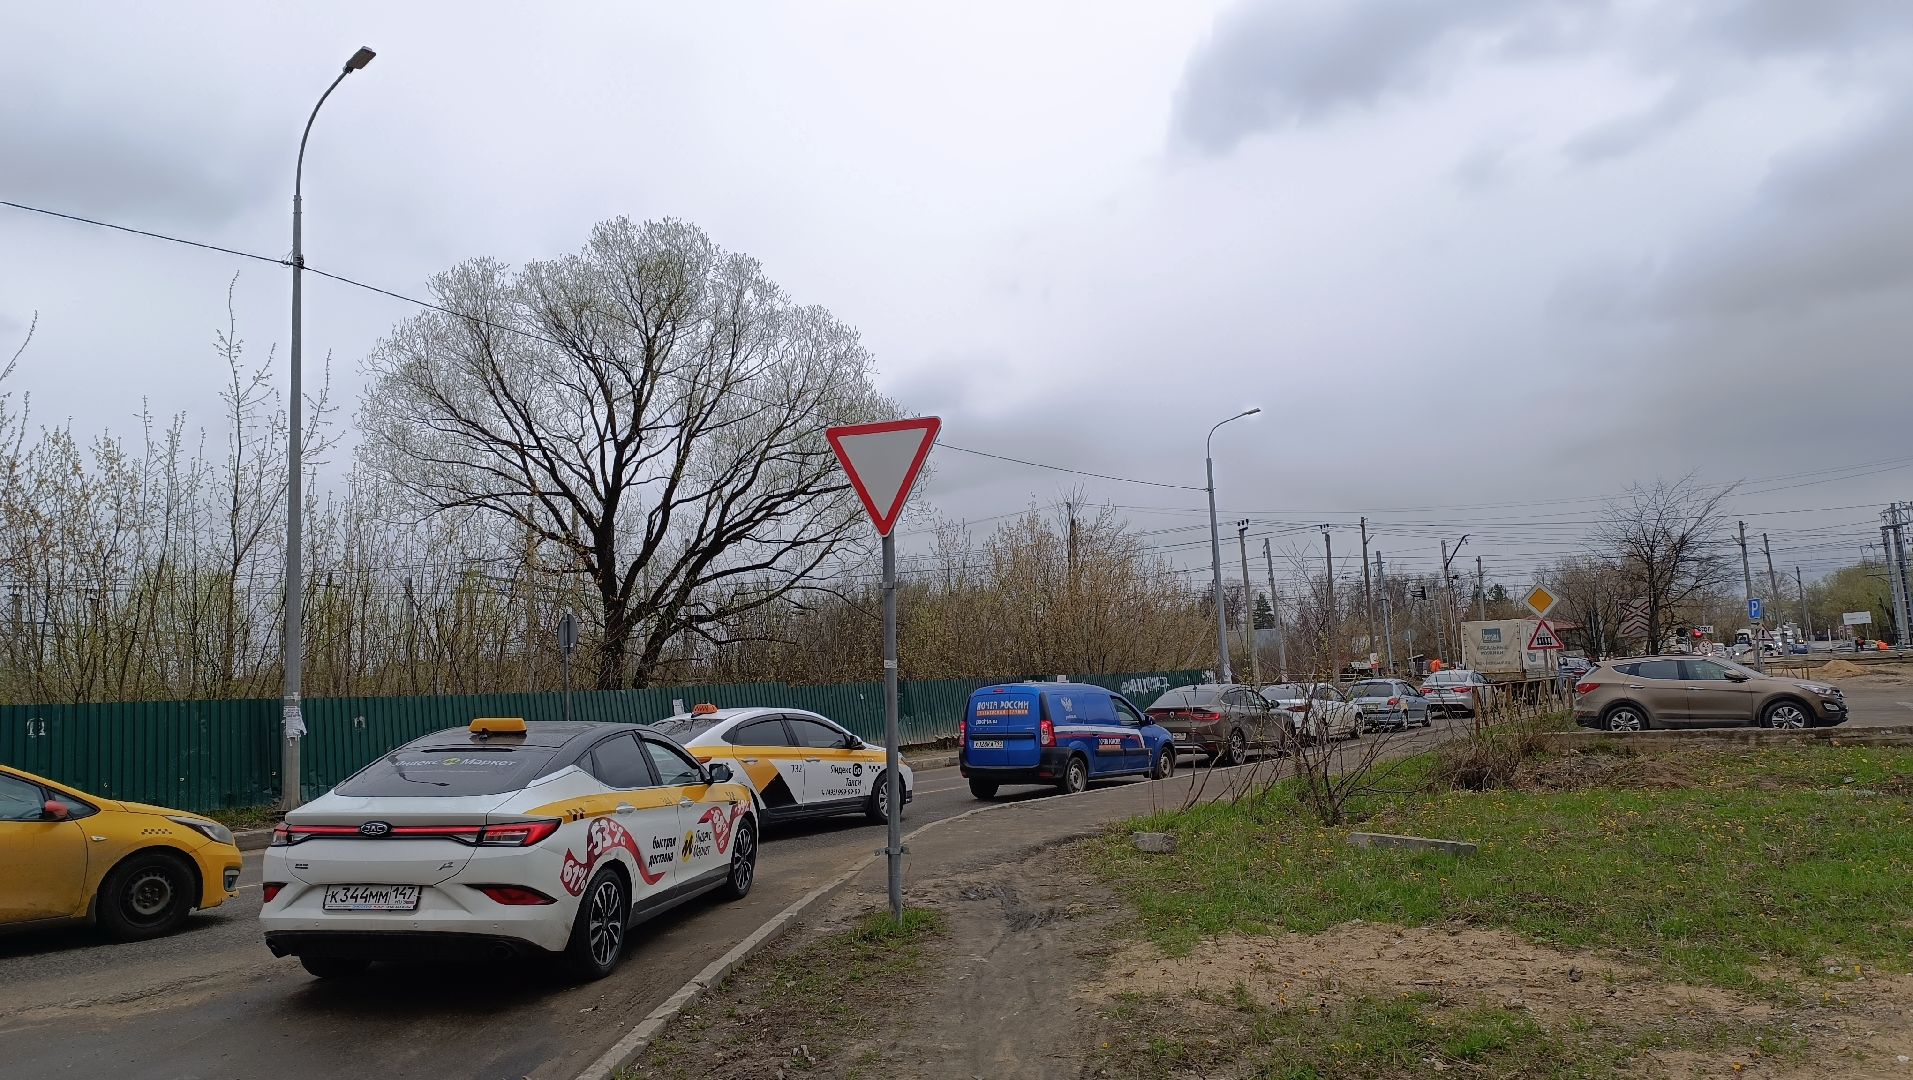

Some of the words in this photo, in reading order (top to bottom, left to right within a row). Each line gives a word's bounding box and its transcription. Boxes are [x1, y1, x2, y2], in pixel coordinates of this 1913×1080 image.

[976, 701, 998, 710] ПОЧТА
[1000, 700, 1029, 710] РОССИИ
[460, 758, 517, 766] Маркет
[830, 764, 852, 775] Яндекс
[845, 777, 862, 787] Такси
[364, 824, 384, 832] JAC
[588, 819, 626, 856] -53%
[652, 835, 677, 850] быстрая
[648, 852, 674, 868] доставка
